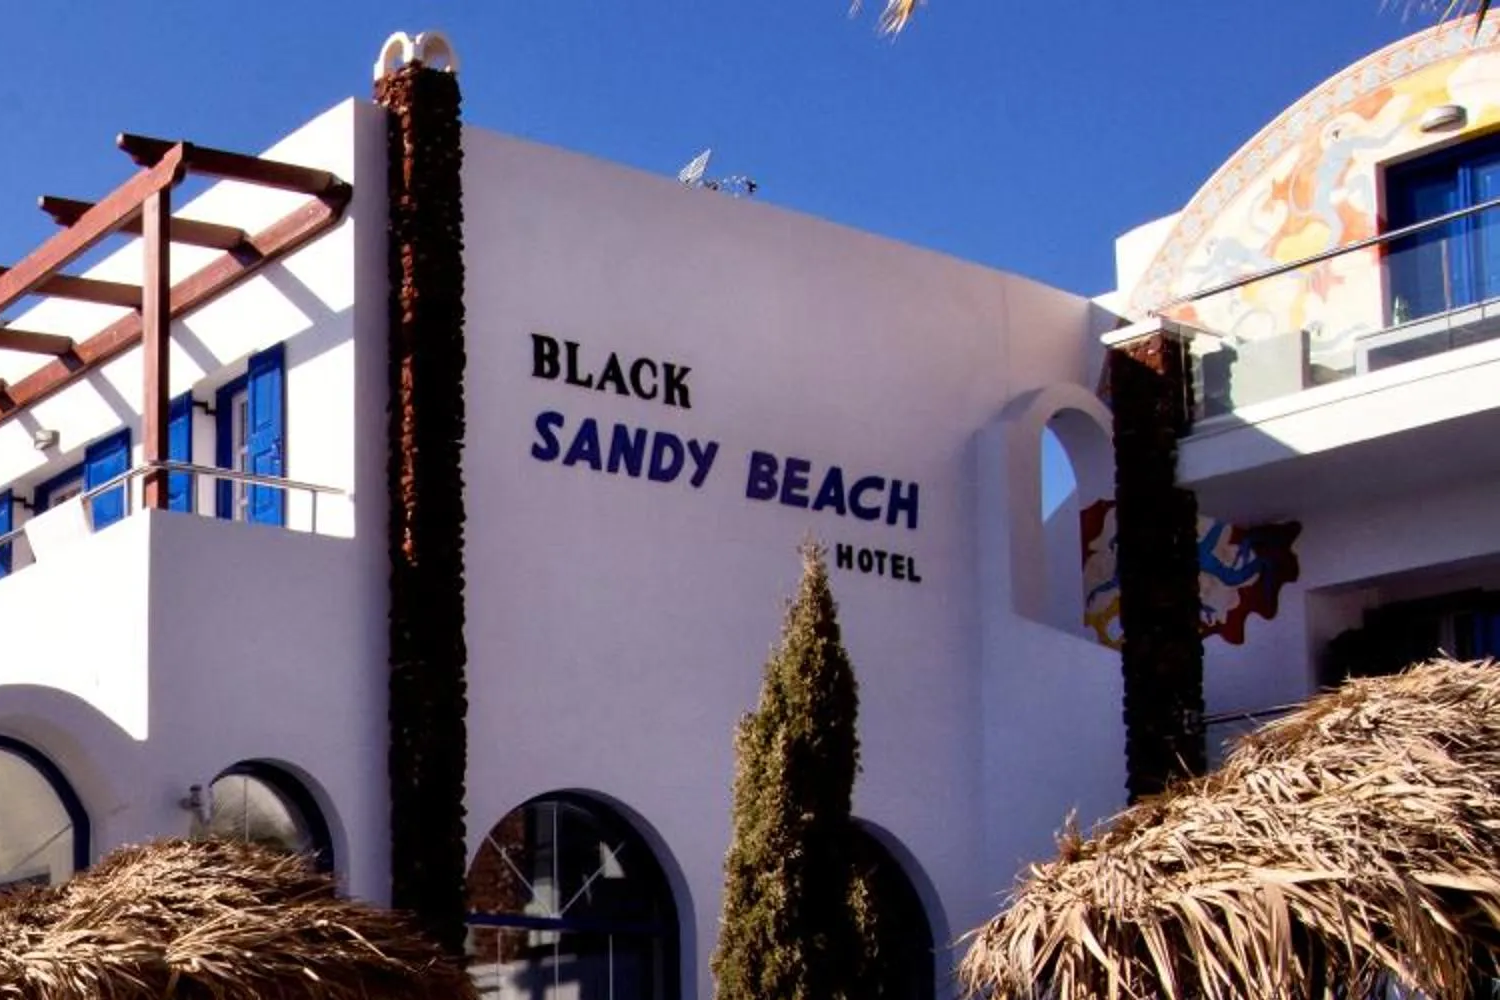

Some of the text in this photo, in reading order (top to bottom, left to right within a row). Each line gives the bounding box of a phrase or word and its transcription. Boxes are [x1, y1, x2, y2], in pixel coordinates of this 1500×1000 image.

[531, 333, 692, 408] BLACK
[531, 411, 920, 530] SANDY BEACH
[836, 542, 922, 583] HOTEL
